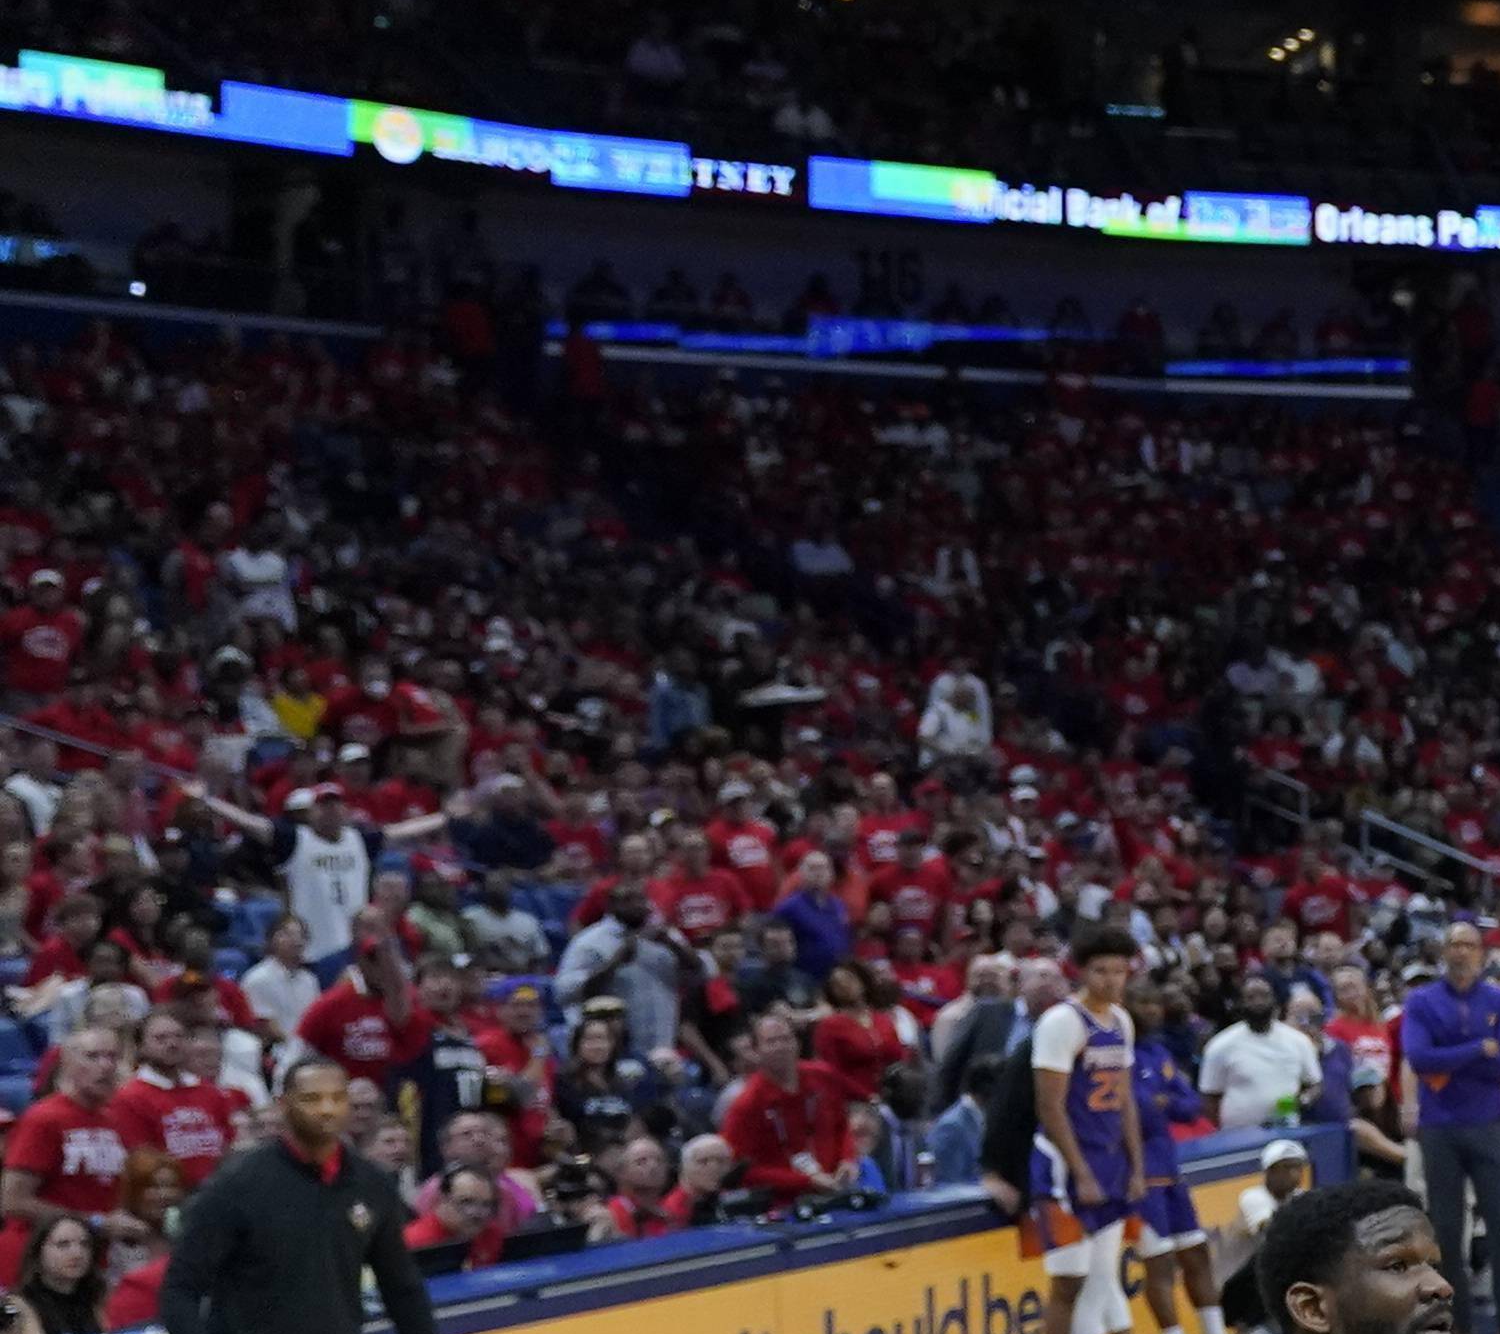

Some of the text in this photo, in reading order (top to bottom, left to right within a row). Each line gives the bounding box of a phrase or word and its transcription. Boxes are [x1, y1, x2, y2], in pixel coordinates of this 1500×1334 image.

[1066, 187, 1139, 233] Bank
[1146, 193, 1181, 233] of
[1316, 202, 1433, 247] Orleans
